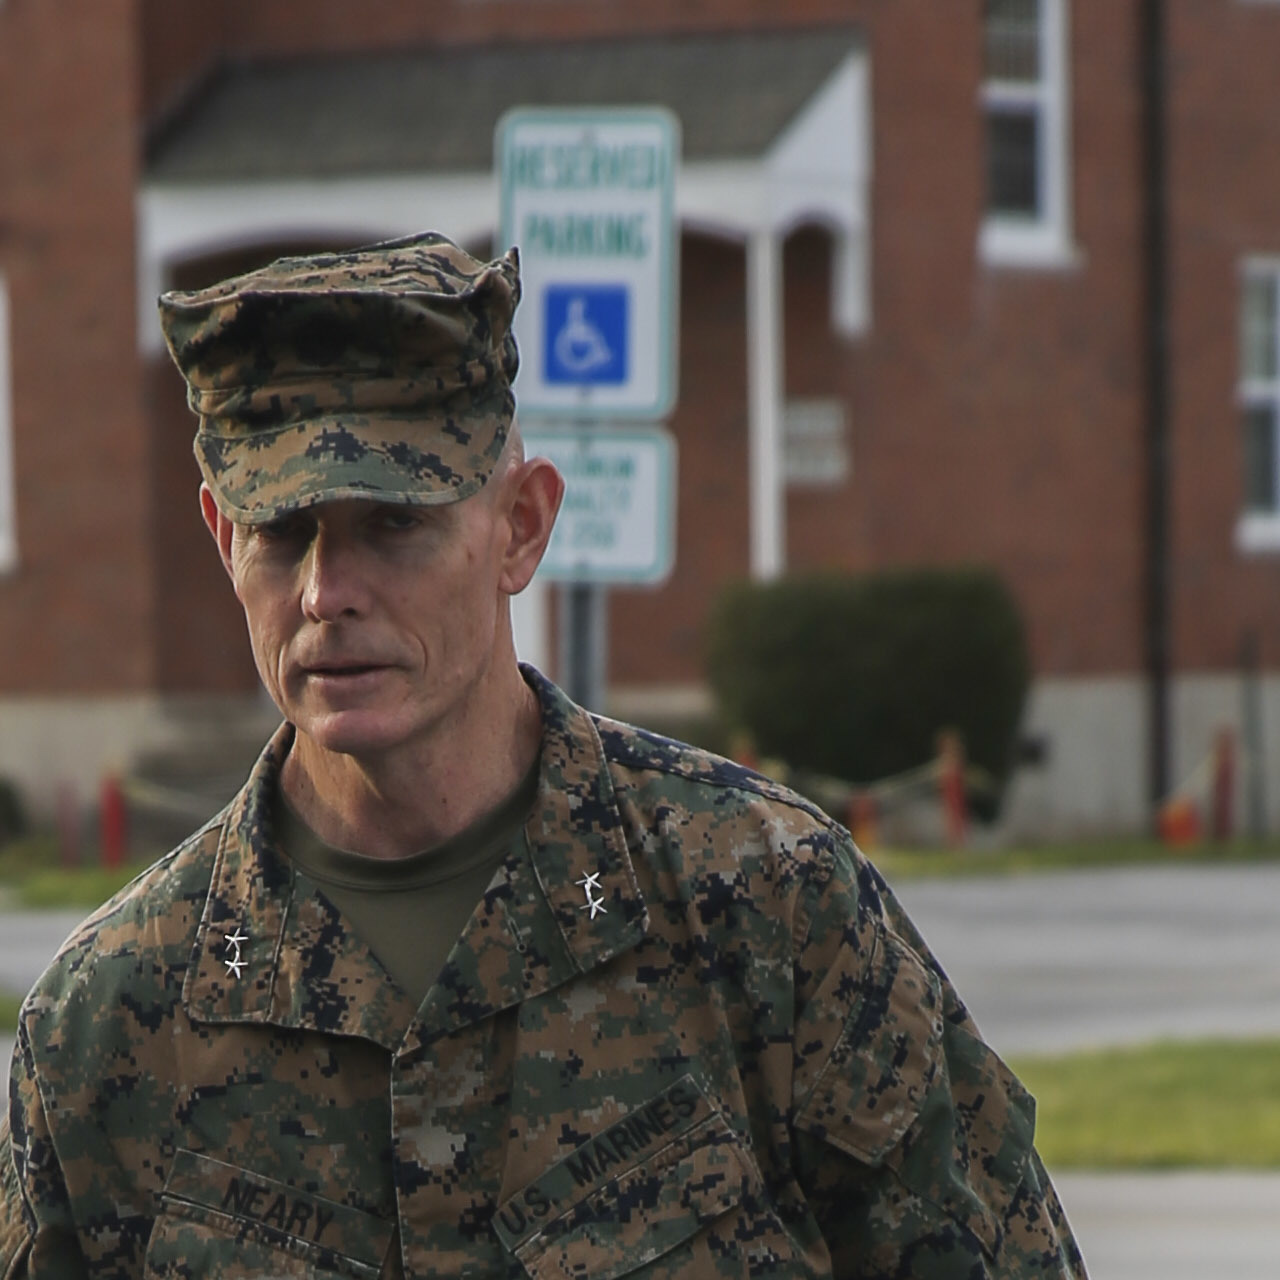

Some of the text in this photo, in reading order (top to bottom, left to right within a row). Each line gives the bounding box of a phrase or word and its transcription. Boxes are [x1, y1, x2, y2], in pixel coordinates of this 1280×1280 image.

[513, 145, 659, 189] RESERVED
[523, 213, 648, 260] PARKING
[499, 1087, 697, 1235] U.S. MARINES
[221, 1177, 335, 1242] NEARY
